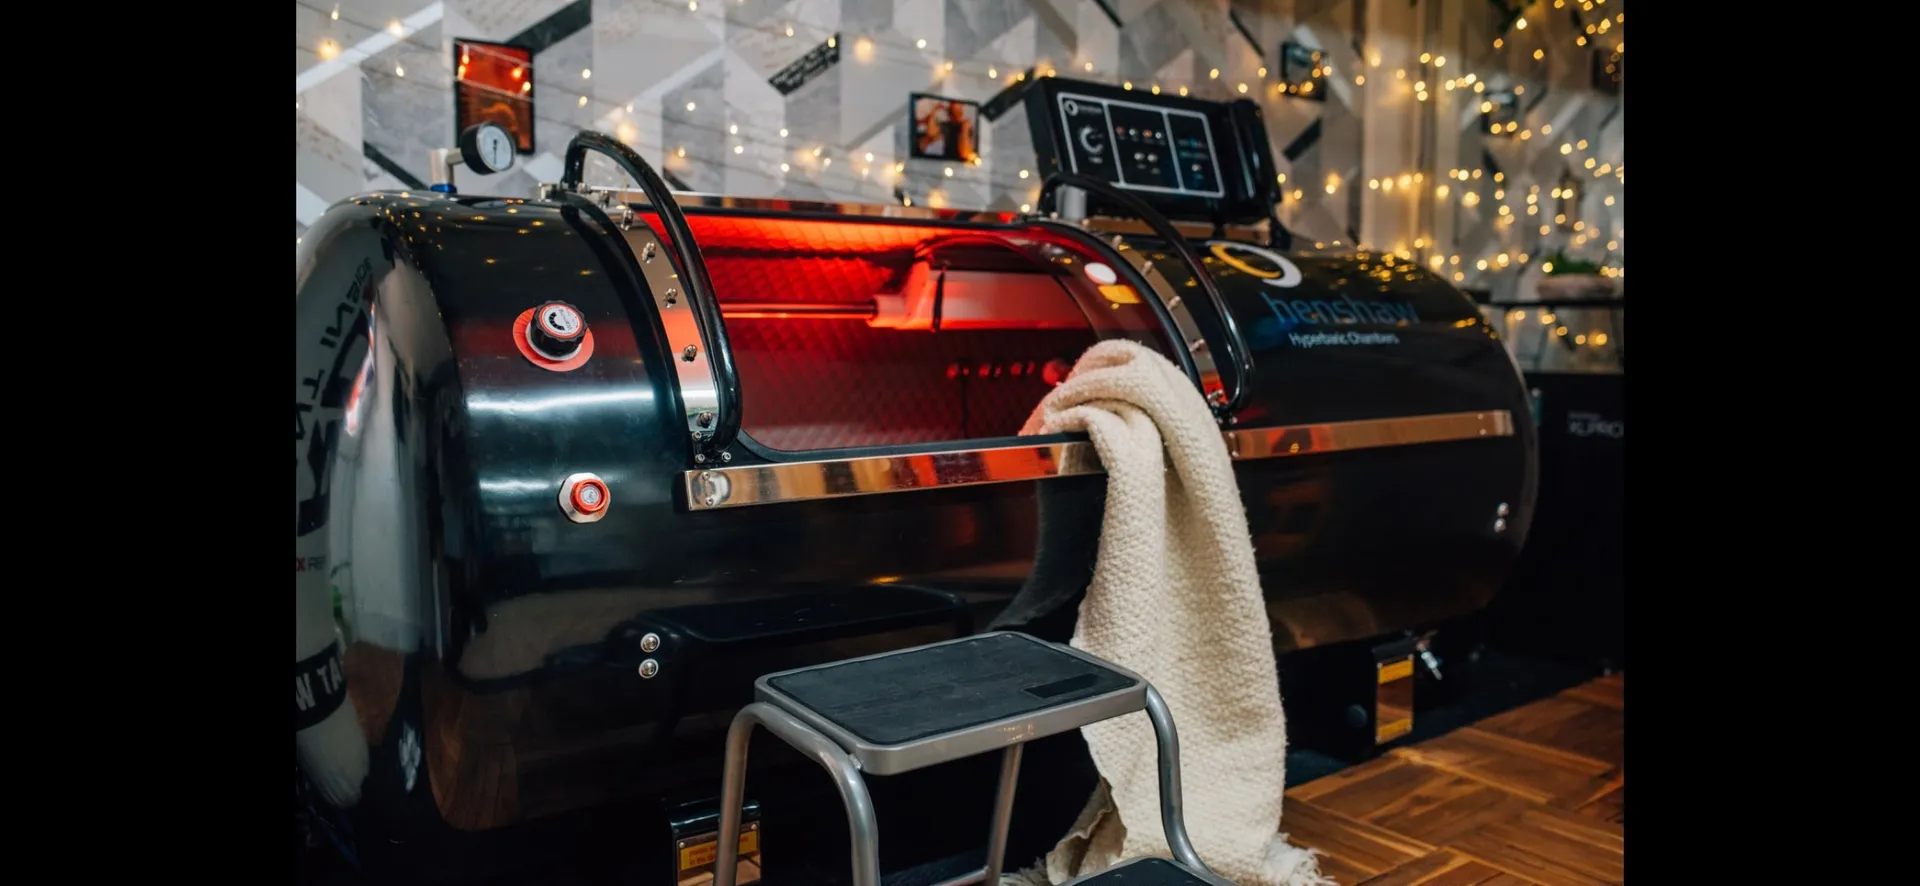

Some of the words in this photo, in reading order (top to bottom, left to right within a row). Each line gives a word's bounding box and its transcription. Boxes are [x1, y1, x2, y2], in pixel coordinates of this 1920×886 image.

[1260, 291, 1421, 325] henshaw
[1288, 332, 1349, 348] Hyperbaric
[1346, 331, 1400, 345] Chambers
